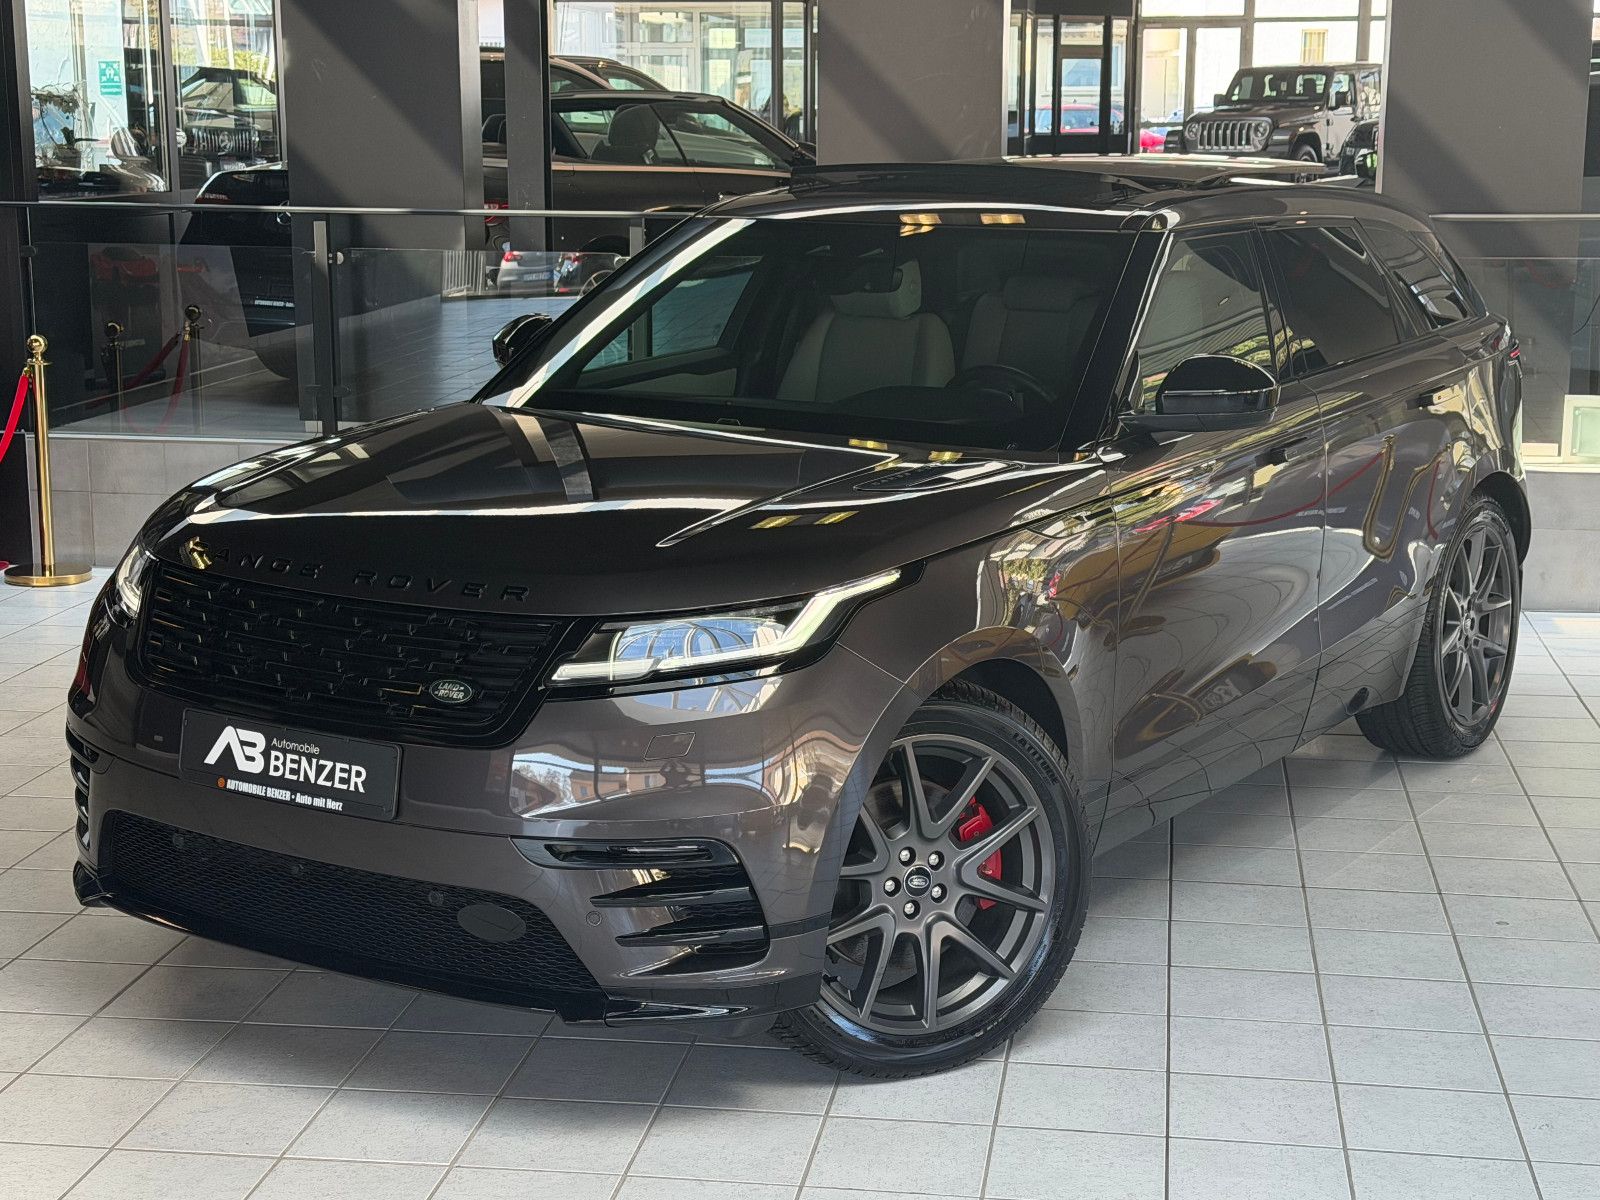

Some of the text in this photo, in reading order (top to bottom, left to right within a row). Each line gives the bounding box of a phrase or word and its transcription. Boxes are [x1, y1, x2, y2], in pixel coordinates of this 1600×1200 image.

[354, 570, 530, 602] ROVER
[437, 682, 460, 691] LAND
[437, 689, 465, 700] ROVER
[203, 725, 266, 774] AB
[271, 737, 320, 755] Automobile
[268, 750, 367, 793] BENZER
[226, 779, 343, 811] AUTOMOBILE BENZER Auto mit Herz
